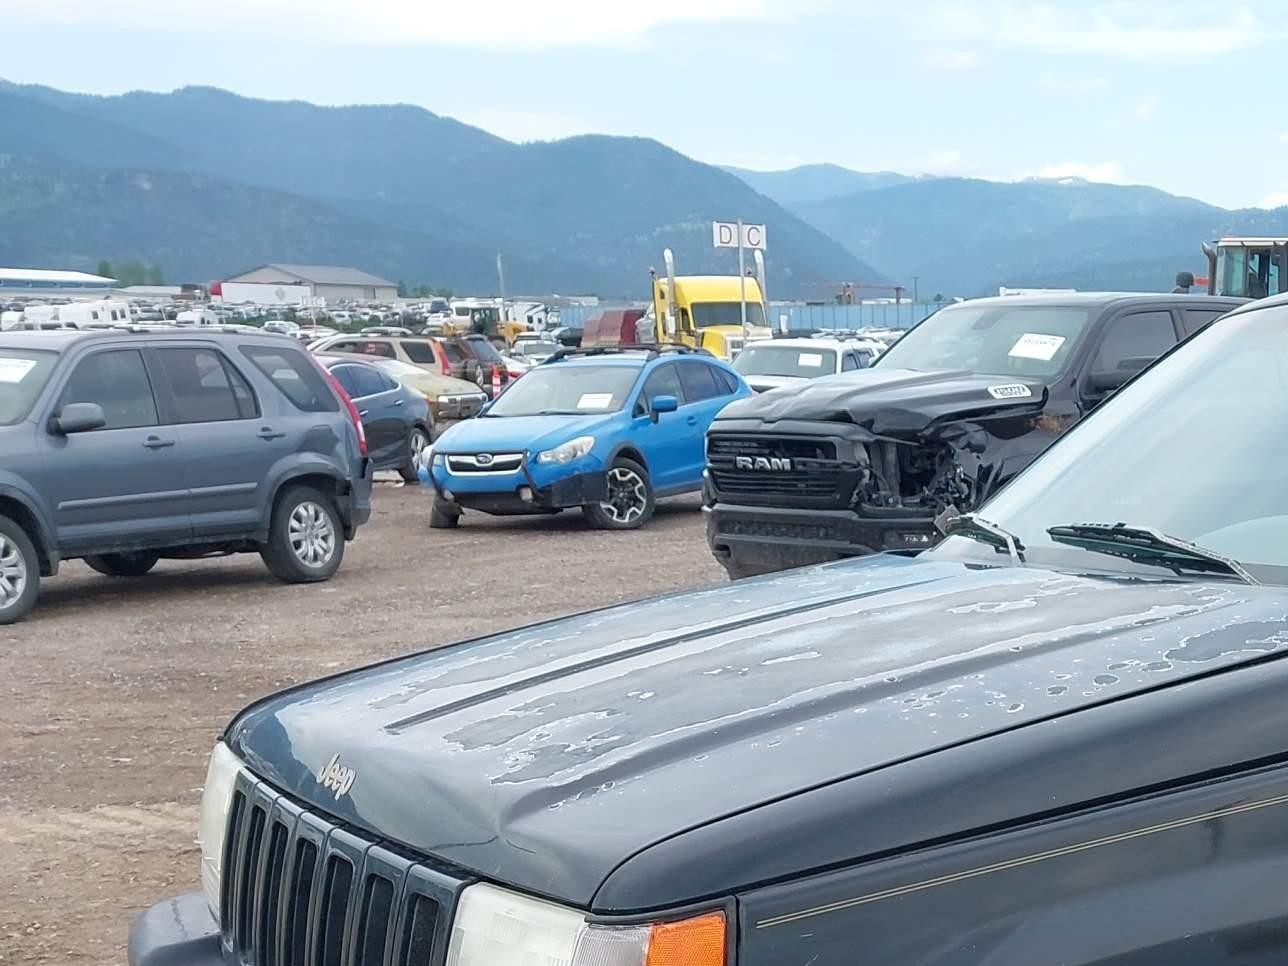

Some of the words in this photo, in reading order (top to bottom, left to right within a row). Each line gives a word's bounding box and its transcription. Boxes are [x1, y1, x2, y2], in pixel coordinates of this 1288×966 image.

[719, 224, 732, 245] D
[747, 226, 761, 247] C
[736, 456, 792, 472] RAM
[315, 752, 356, 801] Jeep
